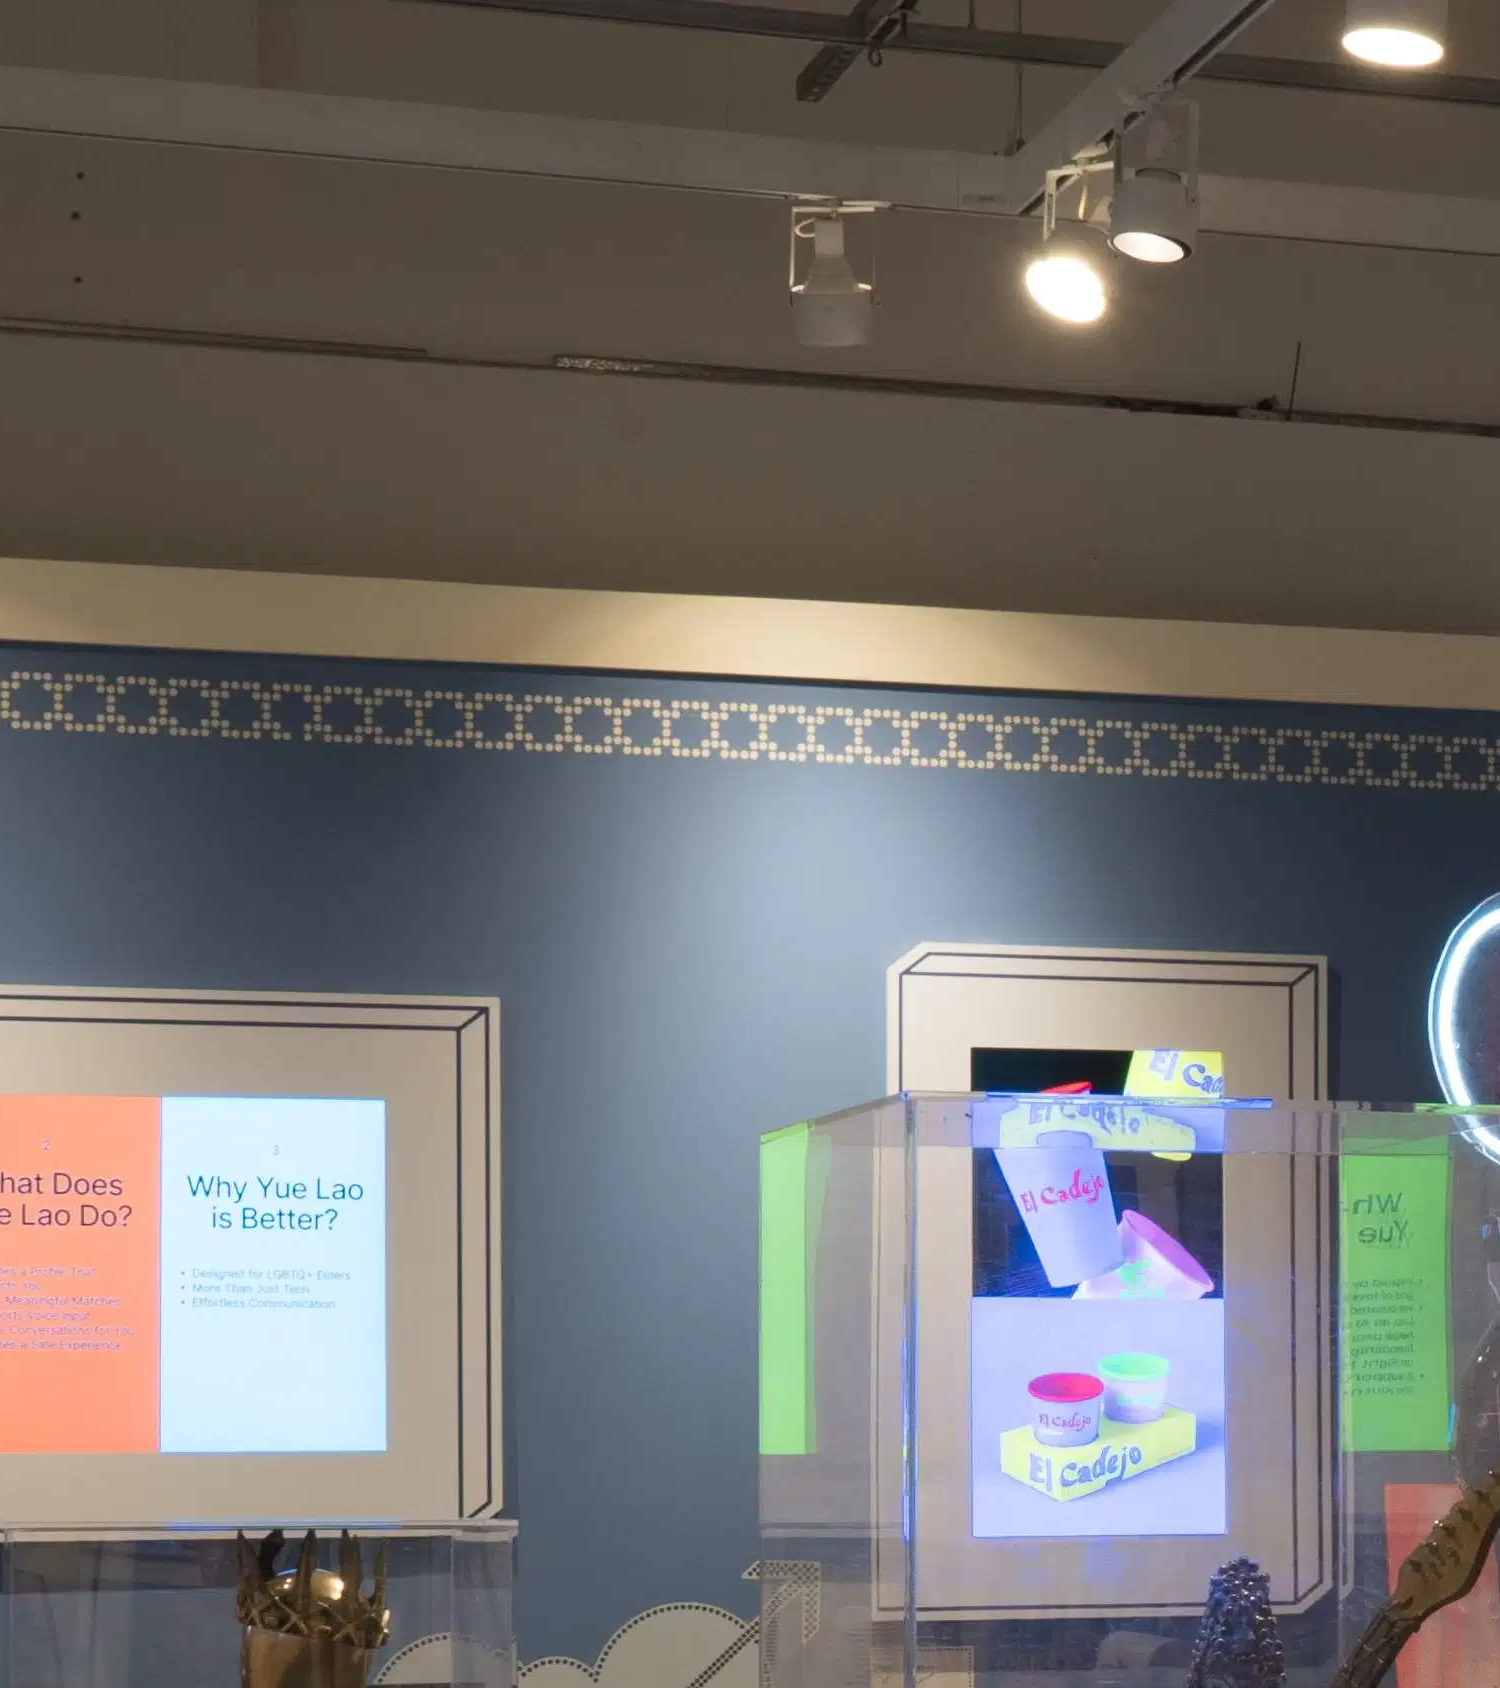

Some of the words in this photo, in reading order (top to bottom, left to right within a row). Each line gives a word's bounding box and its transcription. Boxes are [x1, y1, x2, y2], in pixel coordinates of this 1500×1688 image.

[53, 1172, 123, 1196] Does
[187, 1175, 248, 1204] Why
[257, 1176, 307, 1200] Yue
[316, 1178, 364, 1200] Lao
[1021, 1191, 1037, 1214] El
[1040, 1168, 1105, 1209] Cadejo
[22, 1204, 71, 1226] Lao
[80, 1204, 133, 1228] Do?
[212, 1206, 232, 1229] is
[242, 1207, 338, 1231] Better?
[1029, 1453, 1053, 1493] El
[1059, 1445, 1142, 1488] Cadejo
